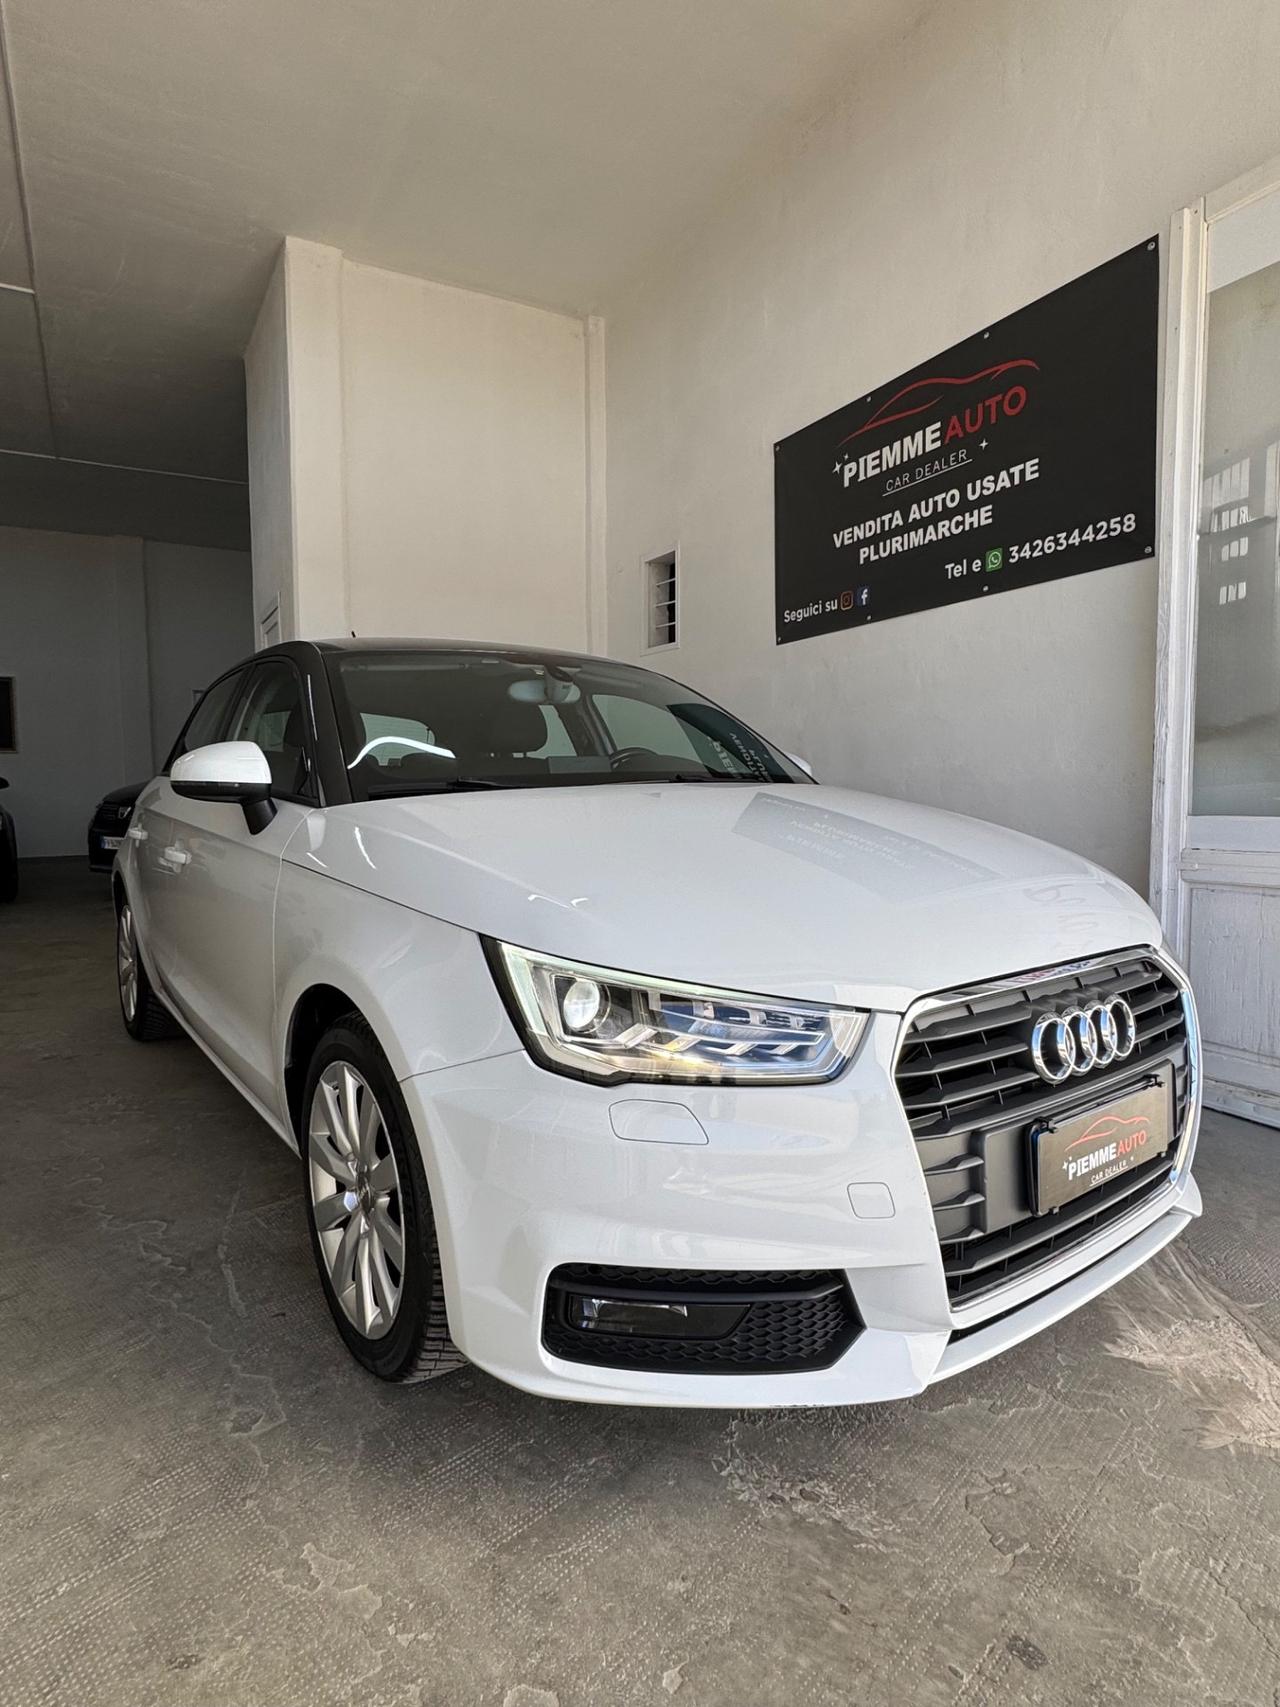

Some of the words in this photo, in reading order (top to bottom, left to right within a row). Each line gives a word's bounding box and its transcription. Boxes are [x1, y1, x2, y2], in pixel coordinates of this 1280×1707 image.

[886, 473, 910, 491] CAR
[915, 449, 967, 480] DEALER
[833, 510, 904, 548] VENDITA
[908, 489, 960, 523] AUTO
[967, 458, 1039, 501] USATE
[859, 505, 993, 564] PLURIMARCHE
[945, 559, 967, 579] Tel
[972, 559, 982, 572] e
[1009, 514, 1136, 563] 3426344258
[784, 600, 822, 622] Seguici
[825, 599, 838, 612] su
[1091, 1171, 1103, 1183] CAR
[1105, 1160, 1127, 1178] DEALER
